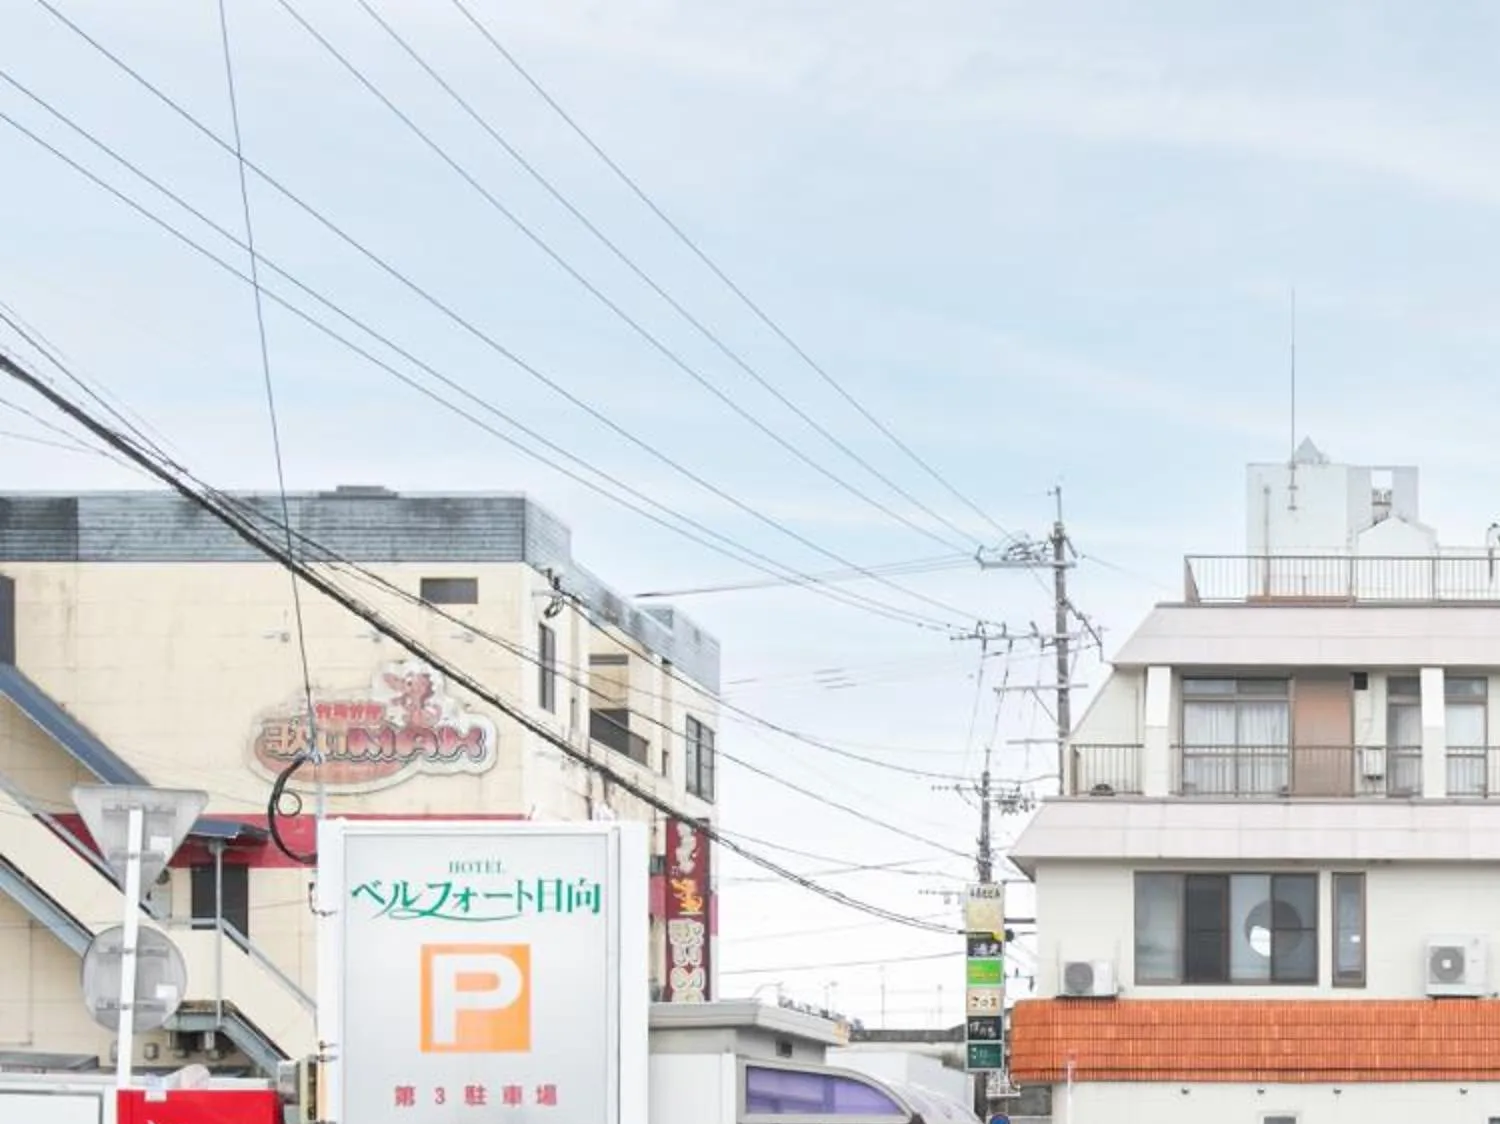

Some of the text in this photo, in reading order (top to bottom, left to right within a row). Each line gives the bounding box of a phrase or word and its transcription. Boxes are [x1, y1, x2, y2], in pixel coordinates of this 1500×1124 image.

[448, 859, 506, 873] HOTEL
[351, 877, 602, 920] ベルフォート日向
[431, 953, 523, 1045] P
[394, 1084, 558, 1107] 第3駐車場
